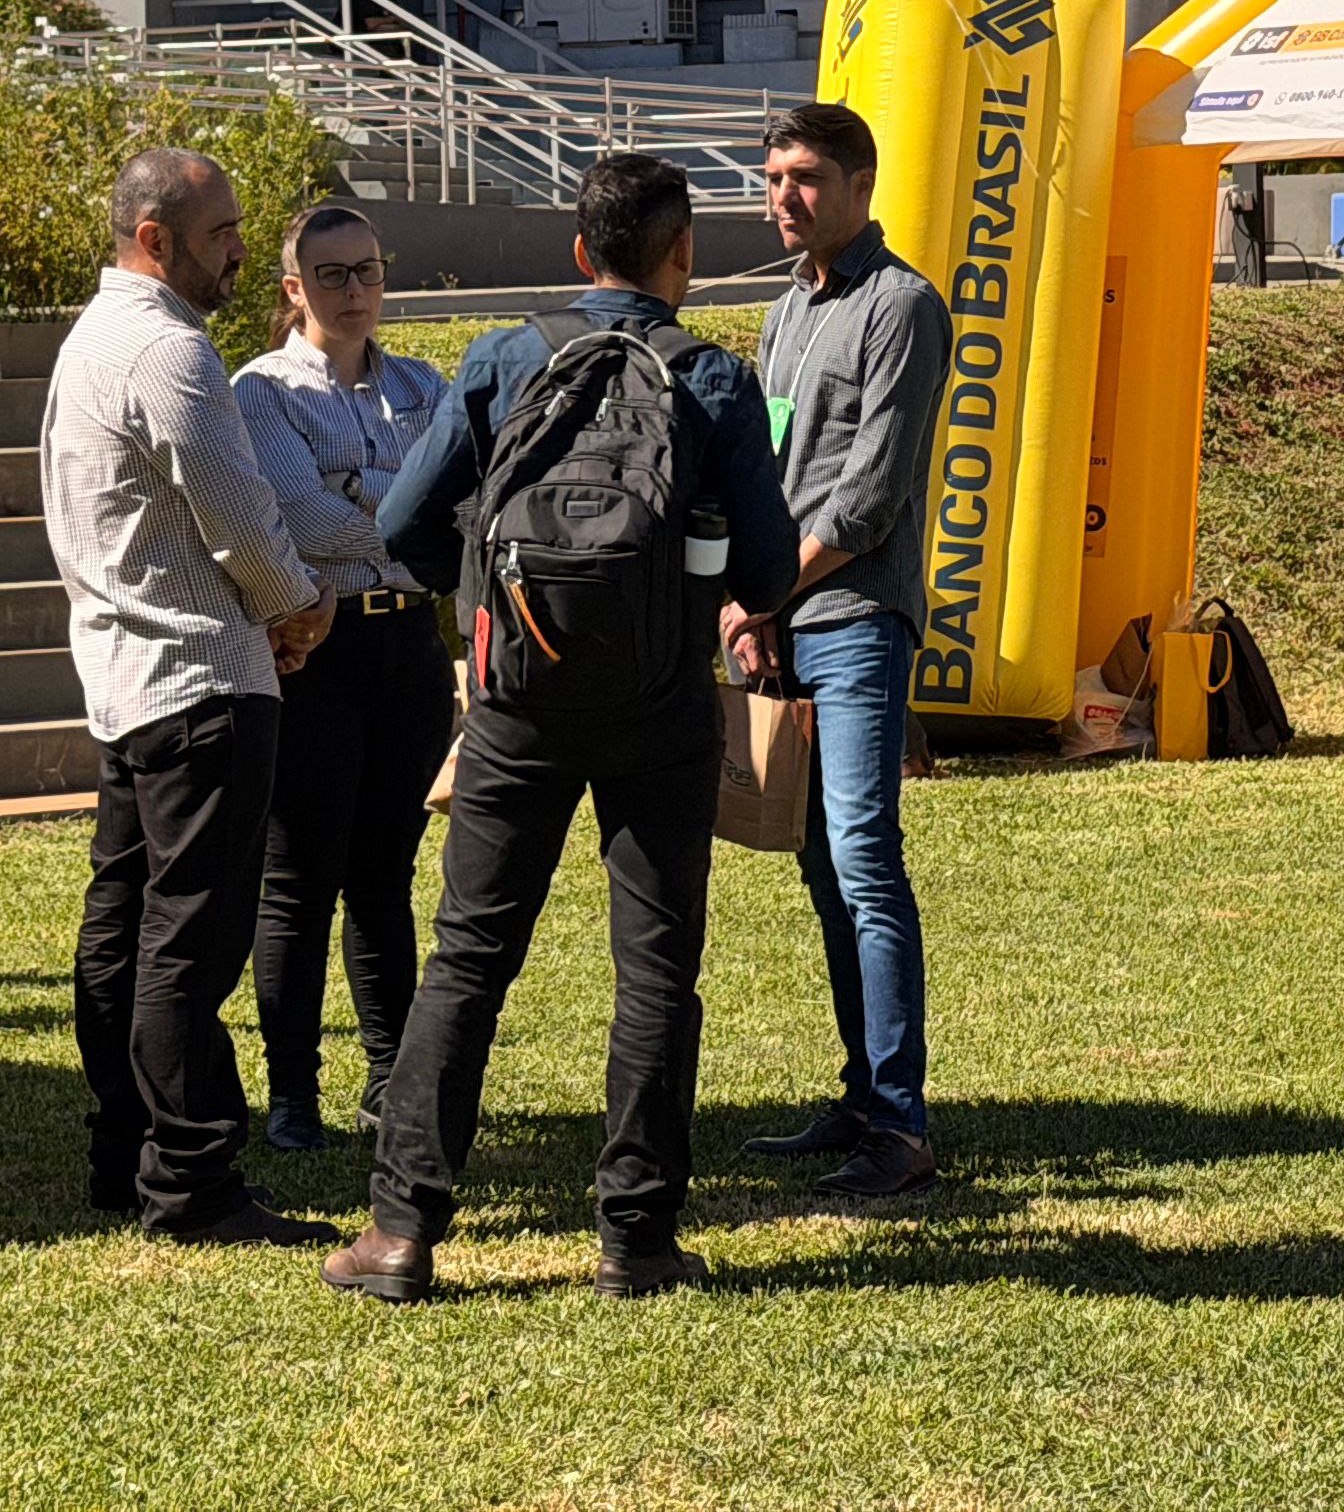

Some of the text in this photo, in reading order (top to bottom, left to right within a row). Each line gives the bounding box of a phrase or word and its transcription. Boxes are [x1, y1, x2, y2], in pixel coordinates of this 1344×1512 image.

[913, 74, 1030, 705] BANCO DO BRASIL
